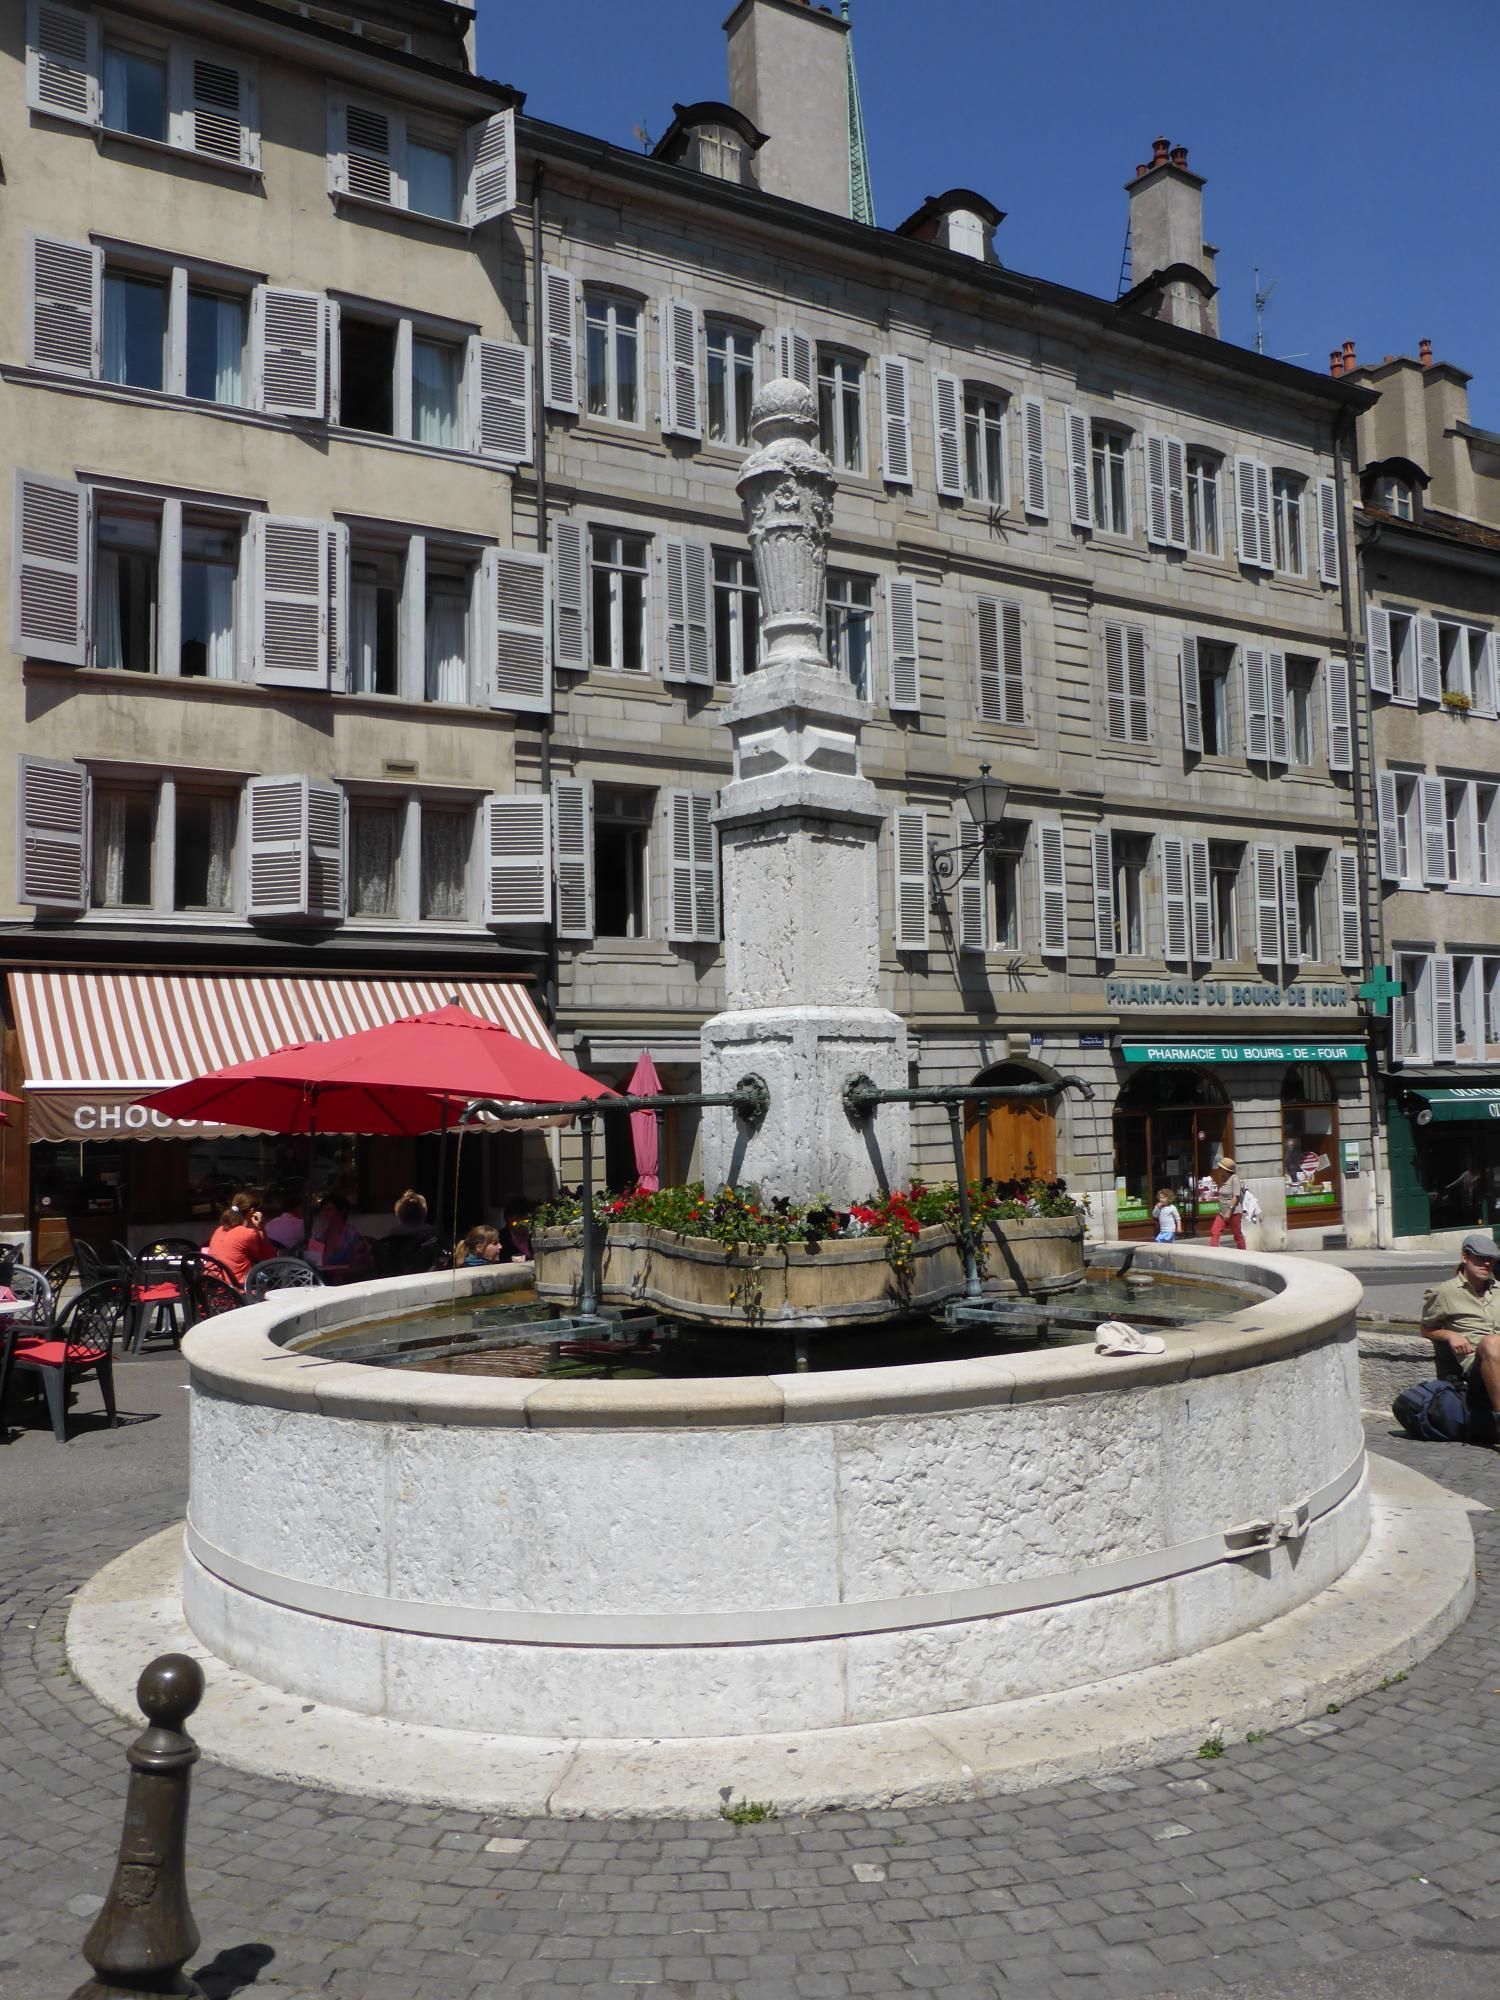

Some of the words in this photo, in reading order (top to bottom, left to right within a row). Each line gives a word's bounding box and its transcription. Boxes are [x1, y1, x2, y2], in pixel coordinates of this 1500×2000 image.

[1107, 983, 1199, 1005] PHARMACIE
[1206, 985, 1226, 1006] DU
[1232, 986, 1280, 1006] BOURG
[1288, 987, 1306, 1007] DE
[1312, 987, 1346, 1007] FOUR
[1147, 1048, 1216, 1060] PHARMACIE
[1221, 1048, 1237, 1059] DU
